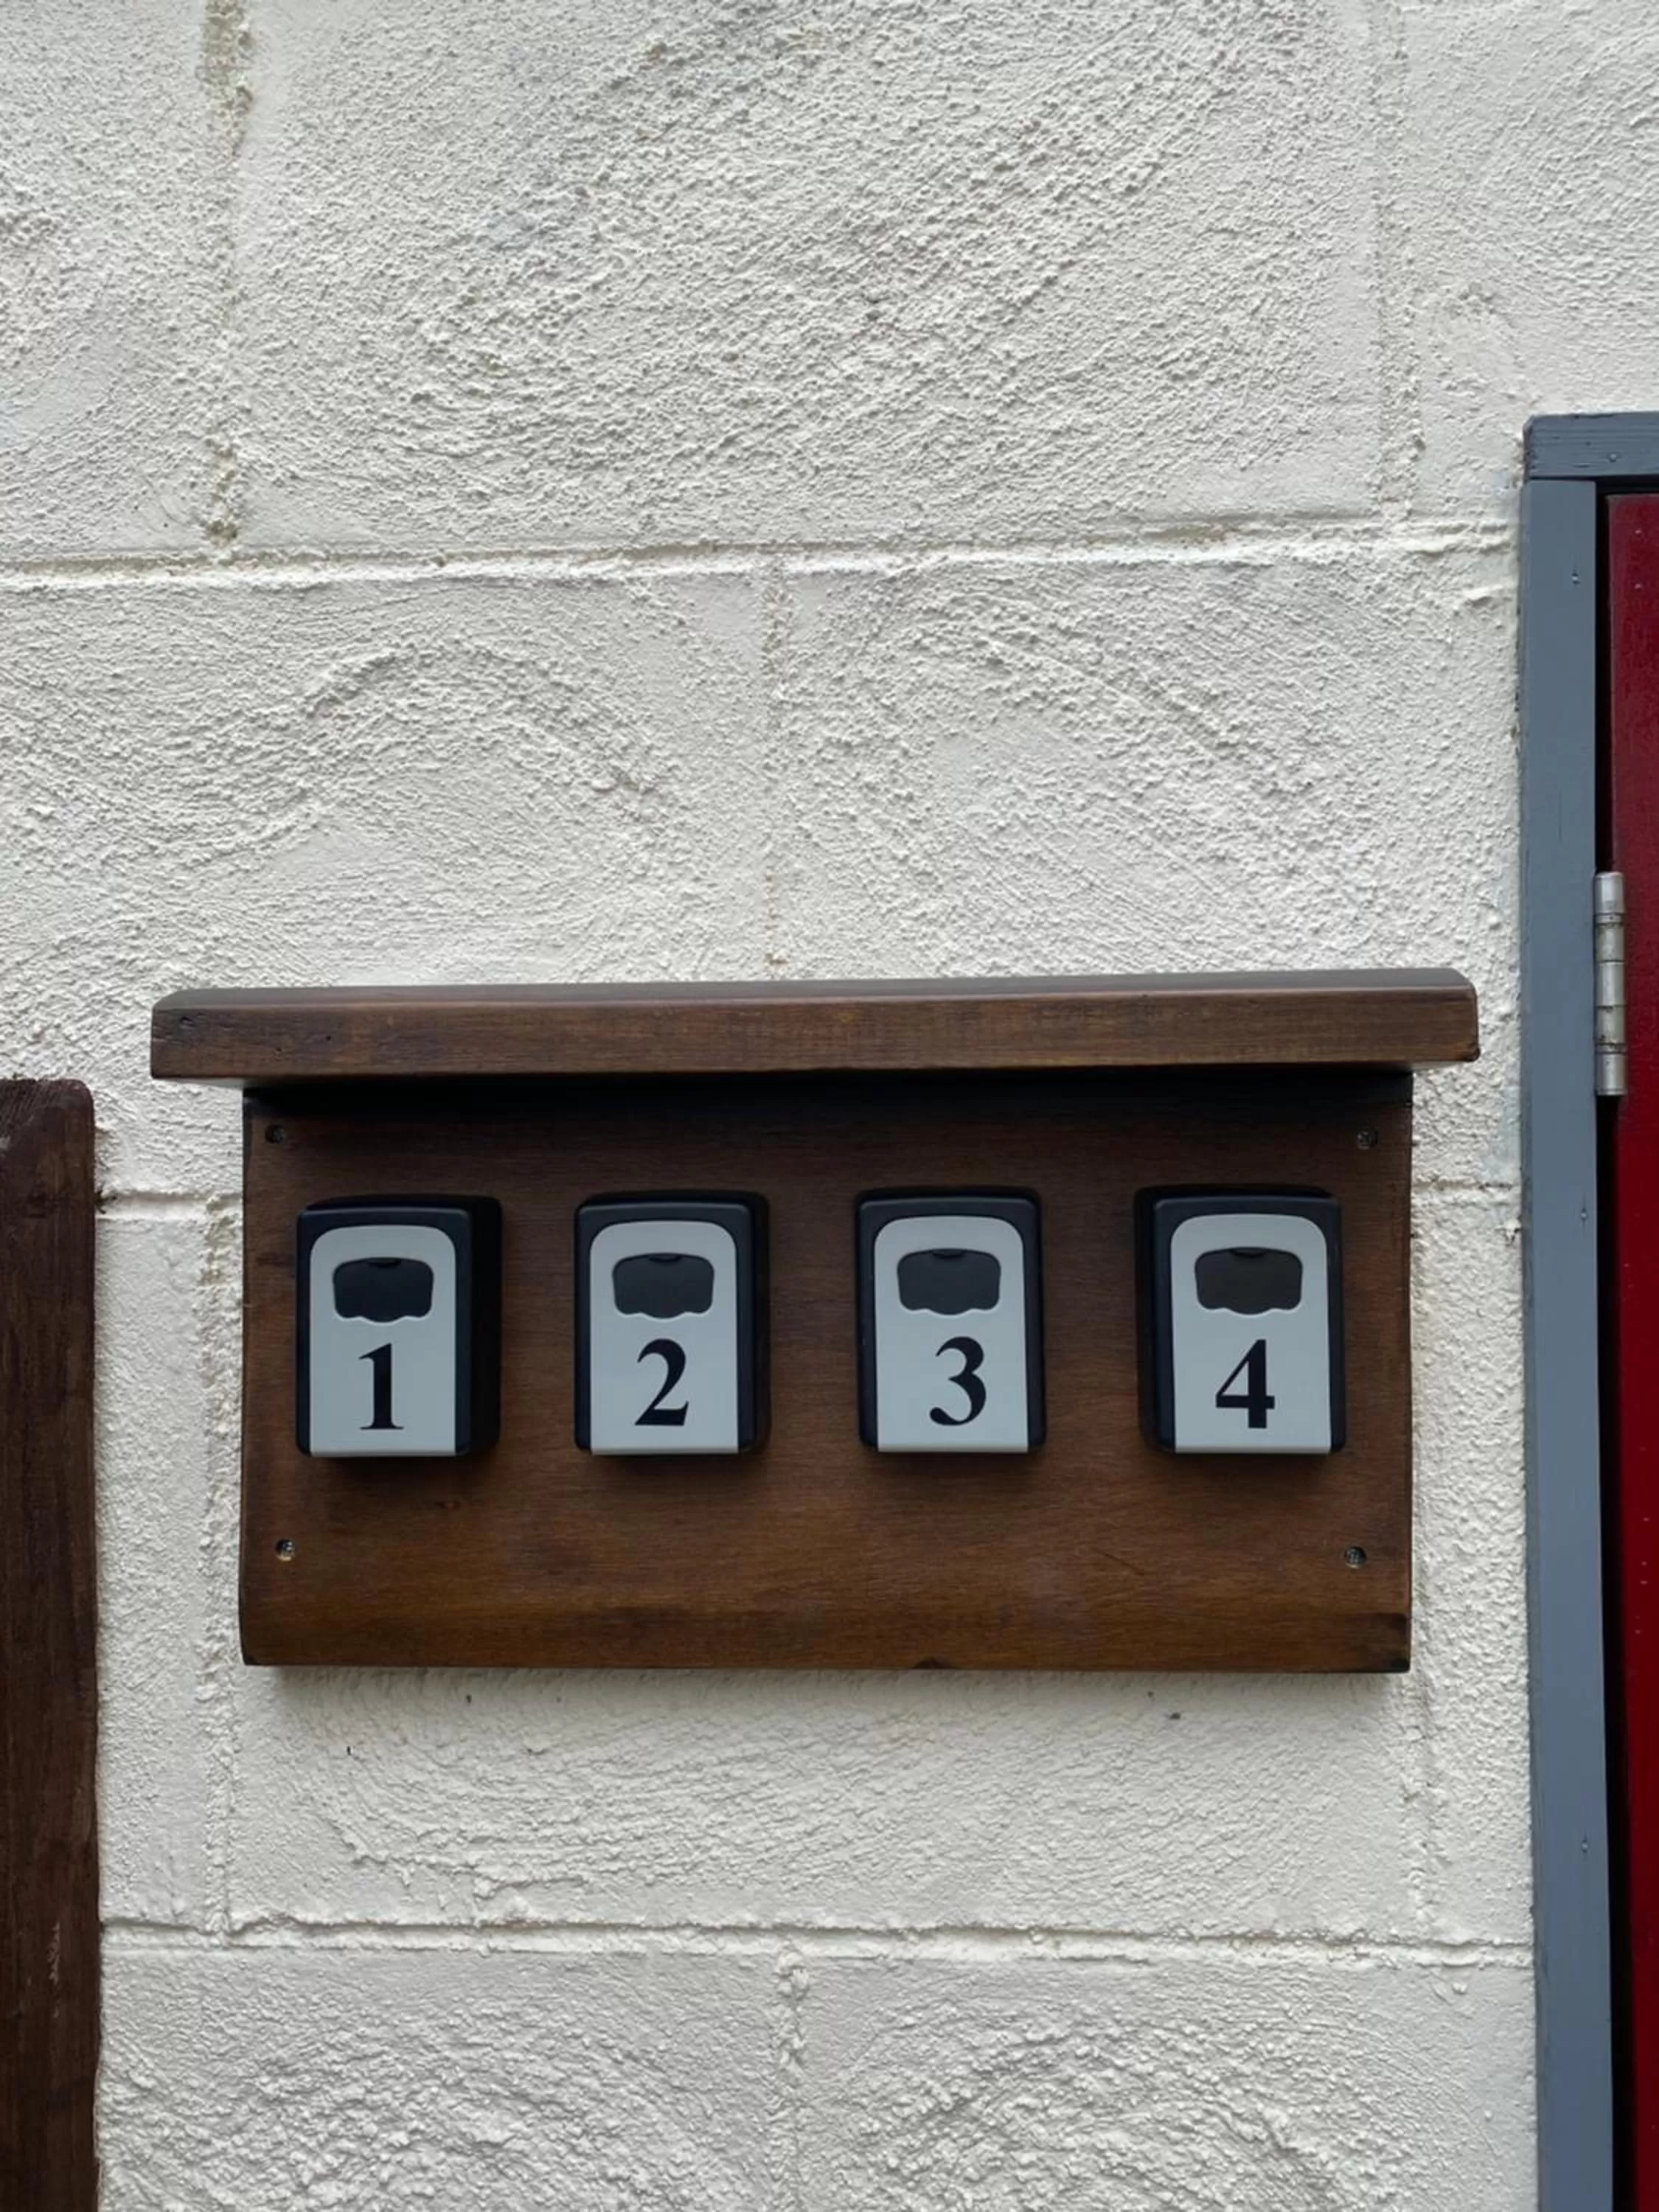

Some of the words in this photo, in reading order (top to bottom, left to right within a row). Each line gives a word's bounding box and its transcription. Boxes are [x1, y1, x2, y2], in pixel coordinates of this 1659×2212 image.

[358, 1342, 404, 1430] 1
[634, 1338, 689, 1427] 2
[929, 1335, 987, 1427] 3
[1215, 1338, 1276, 1430] 4
